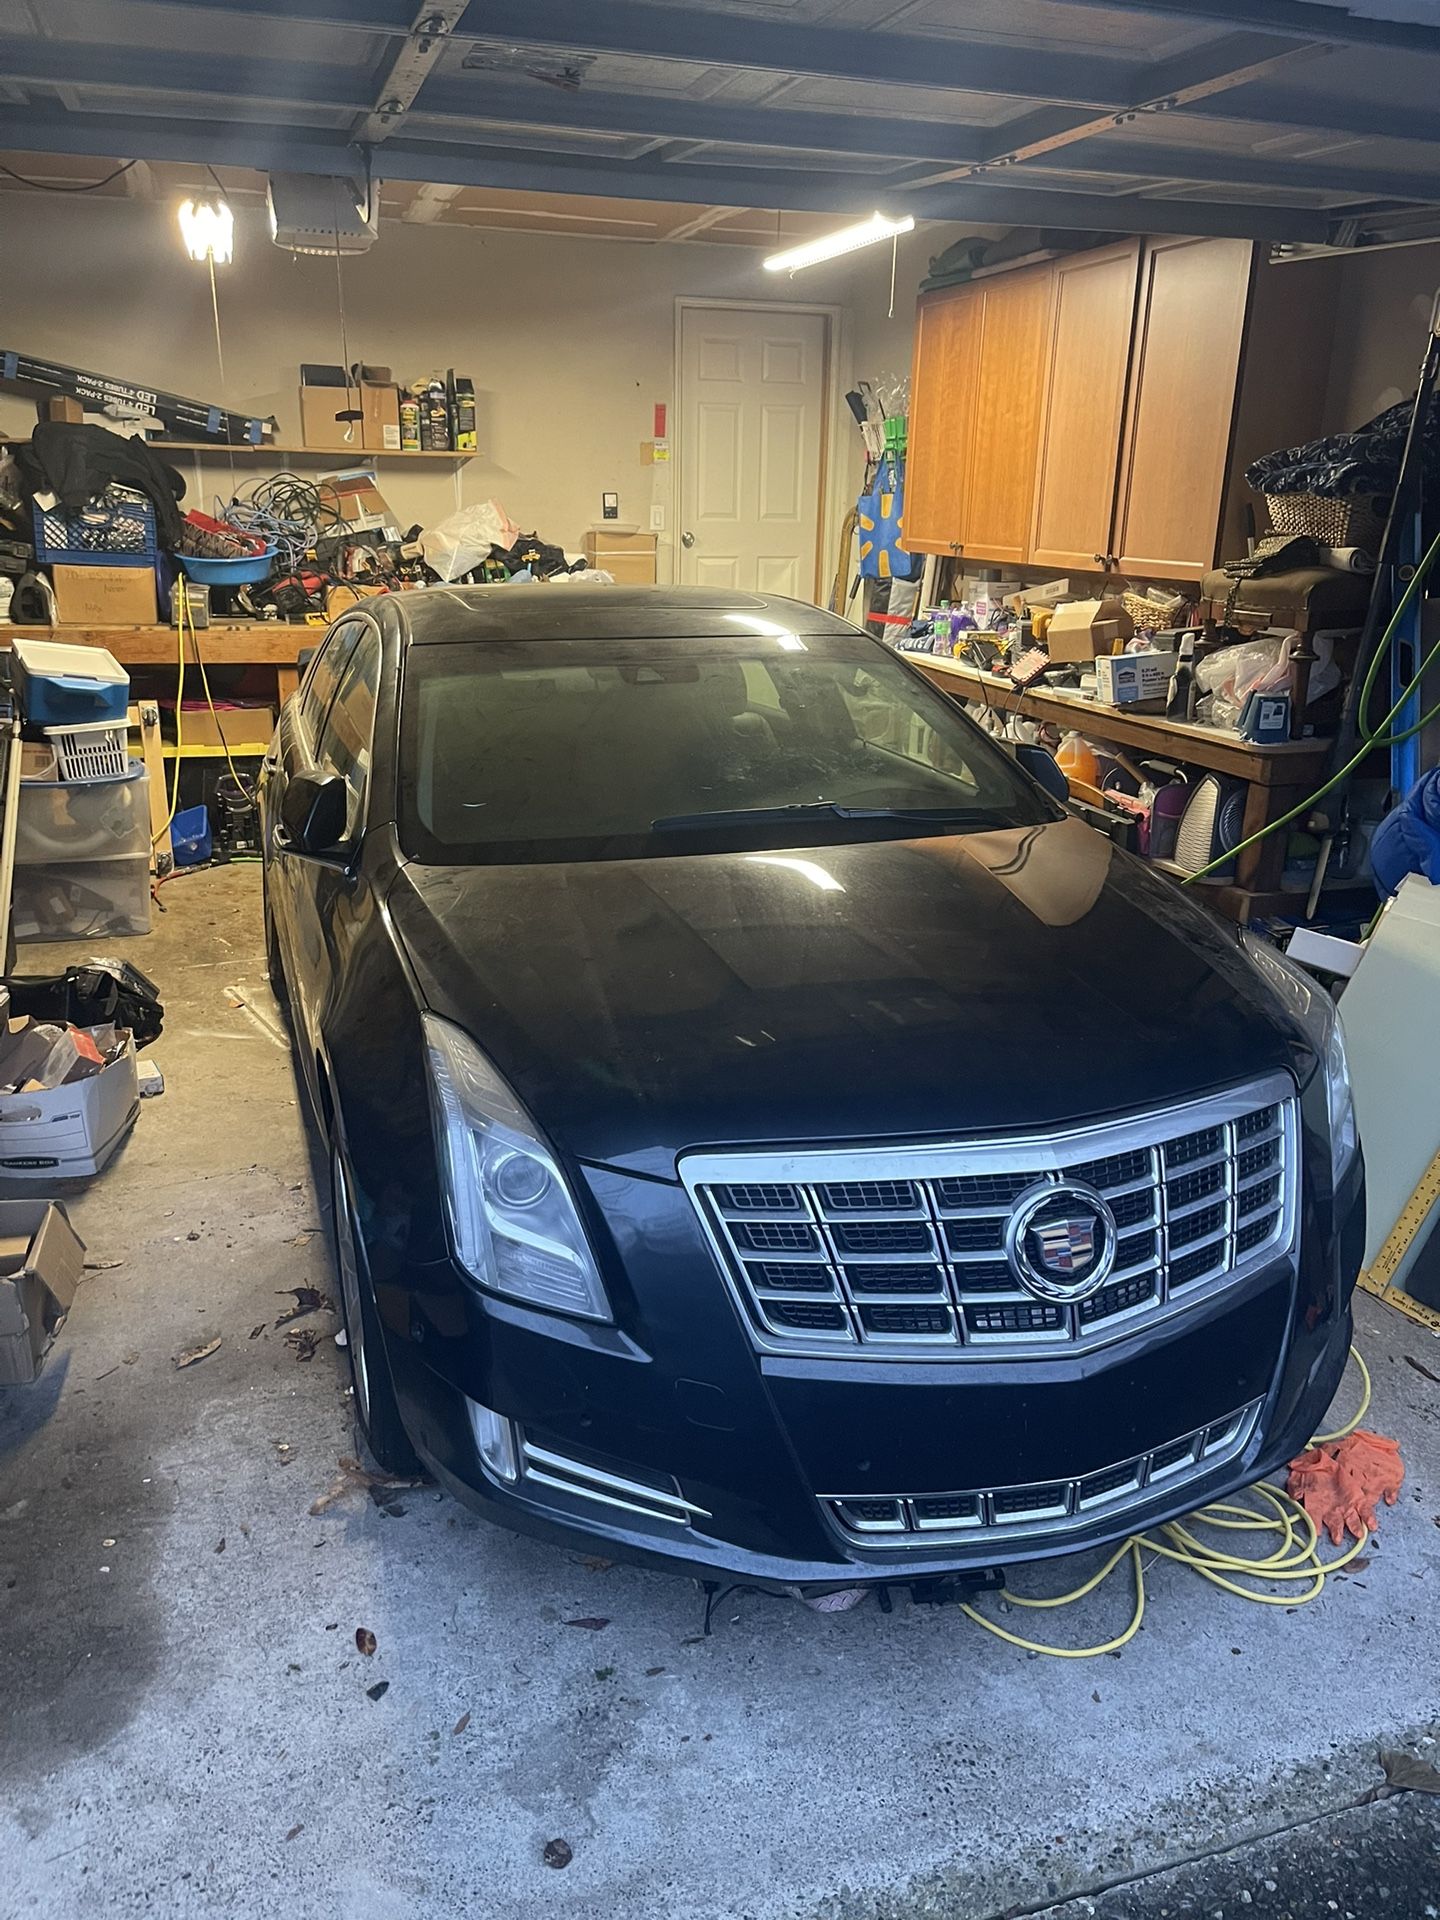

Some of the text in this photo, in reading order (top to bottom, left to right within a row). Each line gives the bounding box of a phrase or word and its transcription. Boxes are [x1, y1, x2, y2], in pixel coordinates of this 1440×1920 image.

[76, 374, 103, 388] 2-PACK
[104, 382, 128, 394] TUBES
[75, 386, 103, 400] 2-PACK
[136, 390, 157, 404] LED
[135, 402, 156, 416] LED
